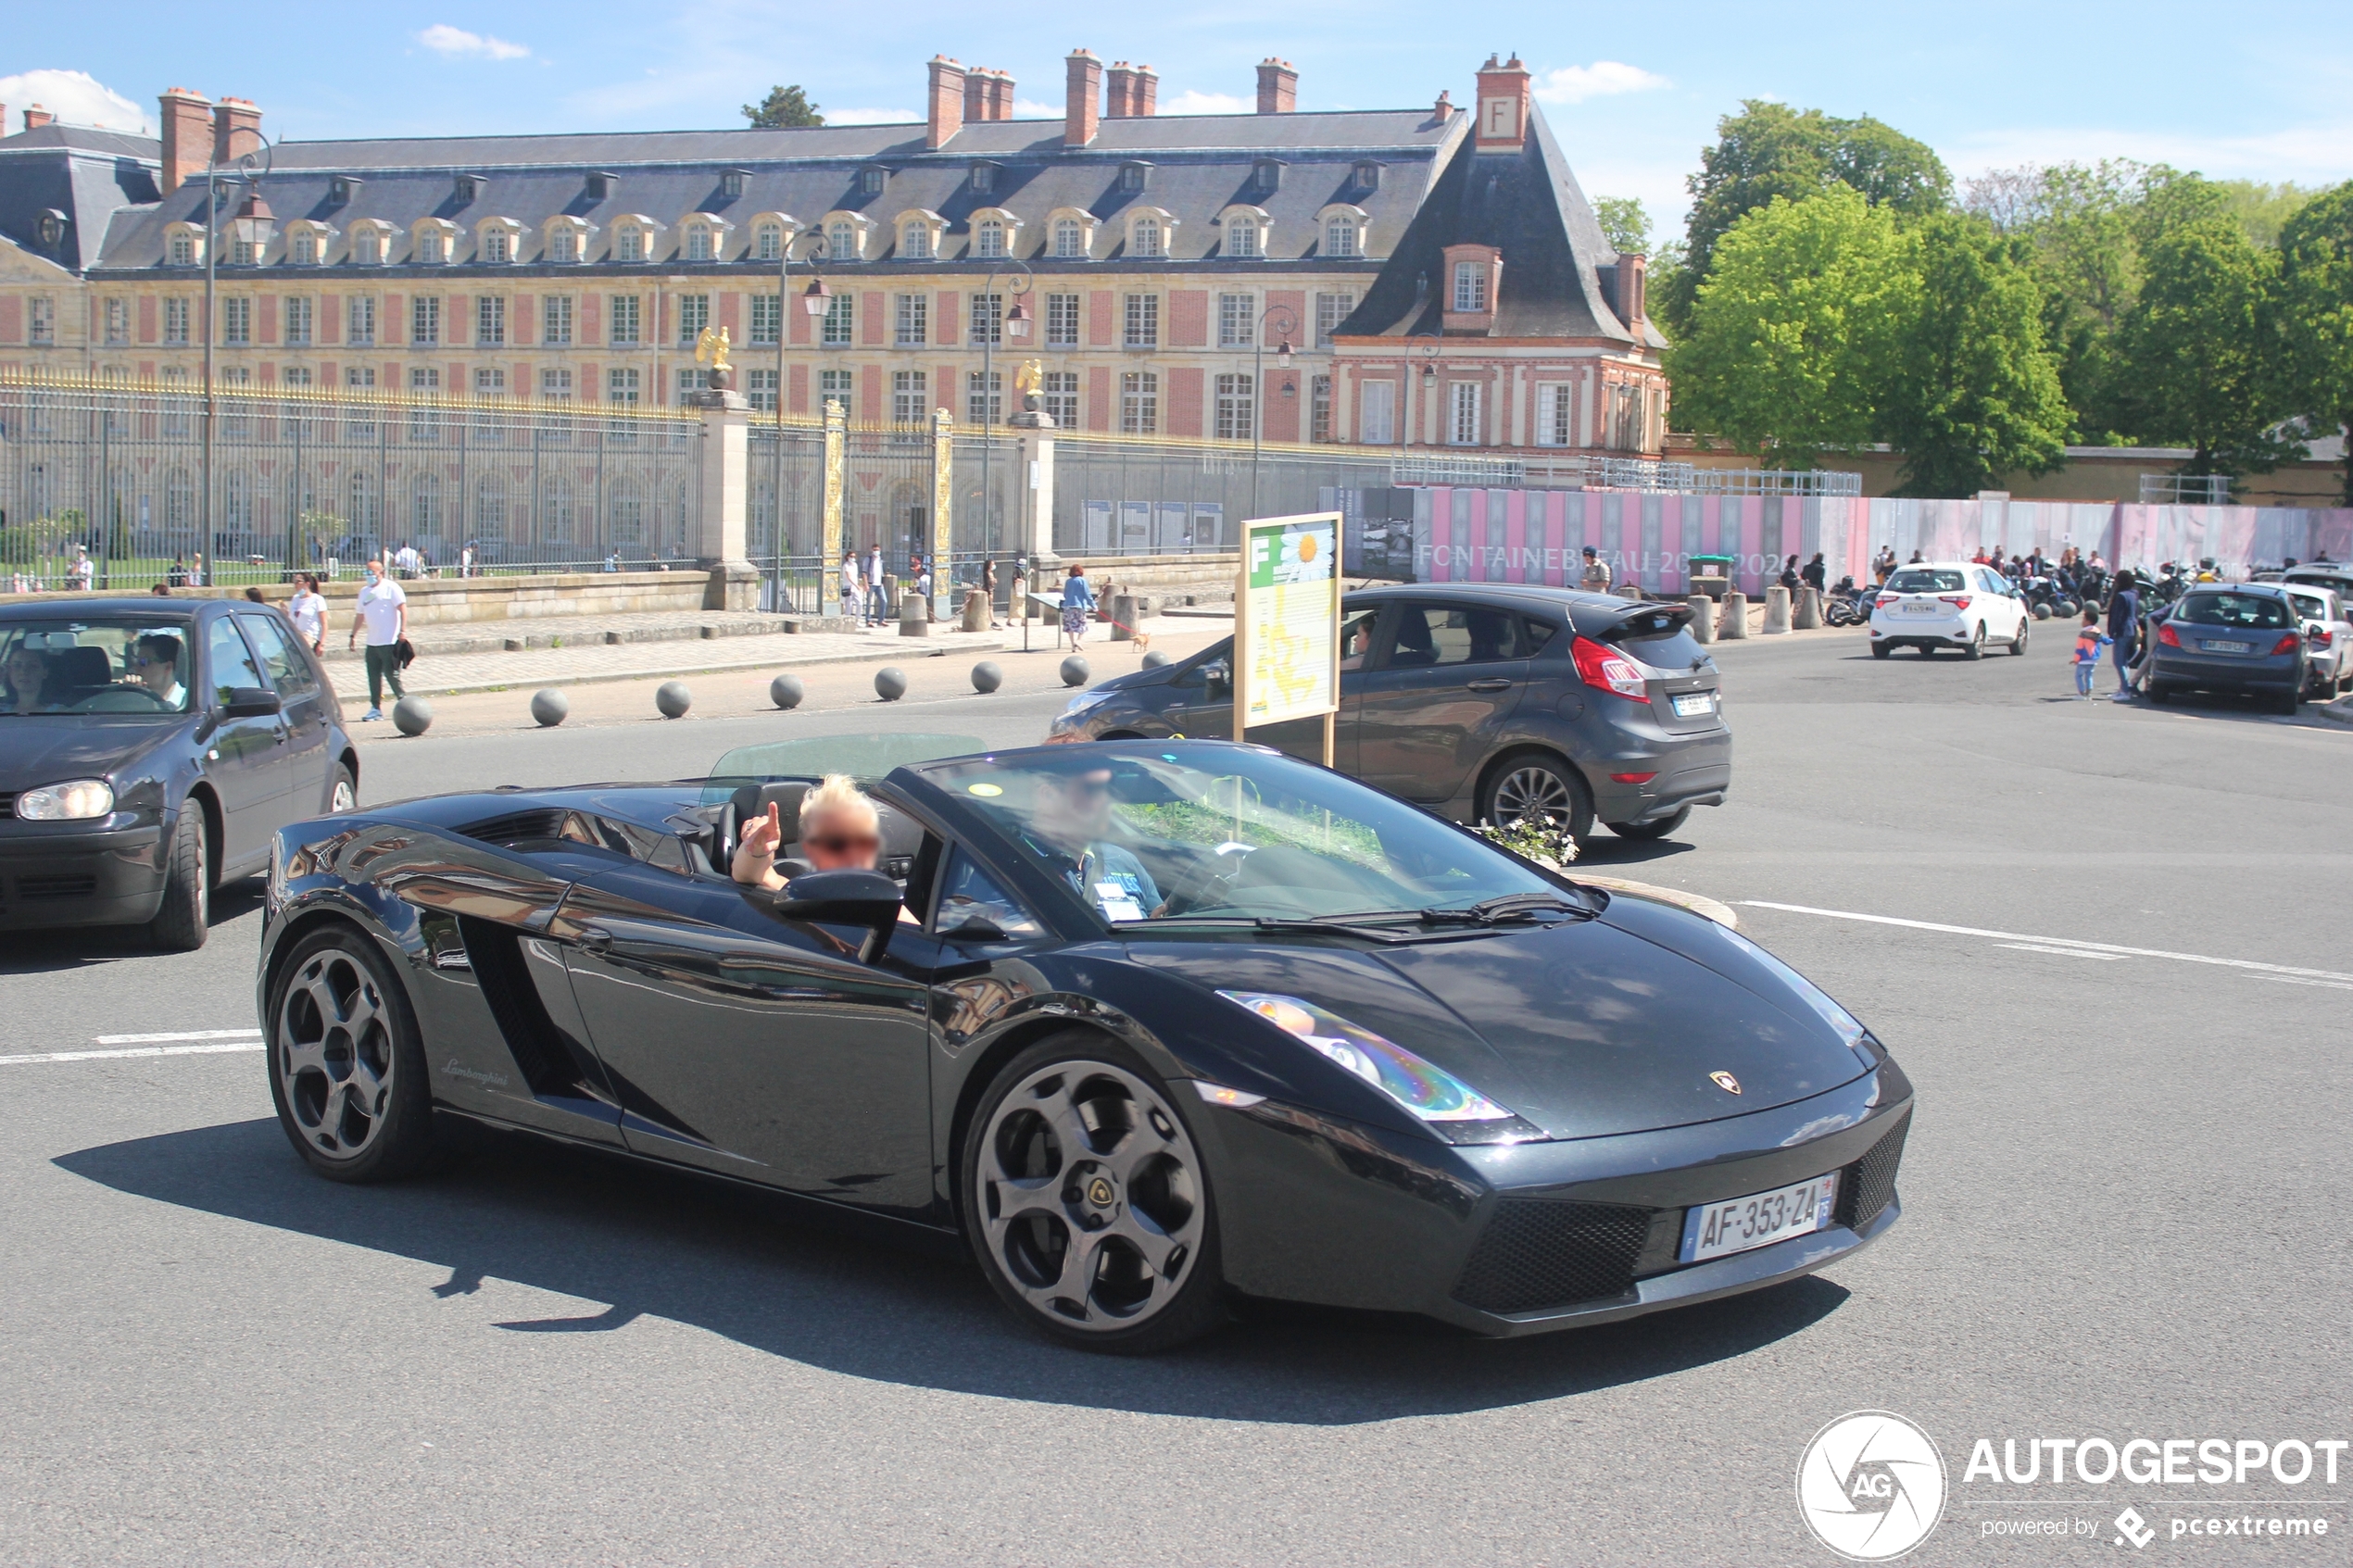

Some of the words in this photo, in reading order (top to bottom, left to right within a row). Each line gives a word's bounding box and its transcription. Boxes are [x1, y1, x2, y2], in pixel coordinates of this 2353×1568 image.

[1251, 538, 1269, 573] F
[441, 1058, 509, 1085] Lamborghini
[1701, 1185, 1818, 1249] AF-353-ZA
